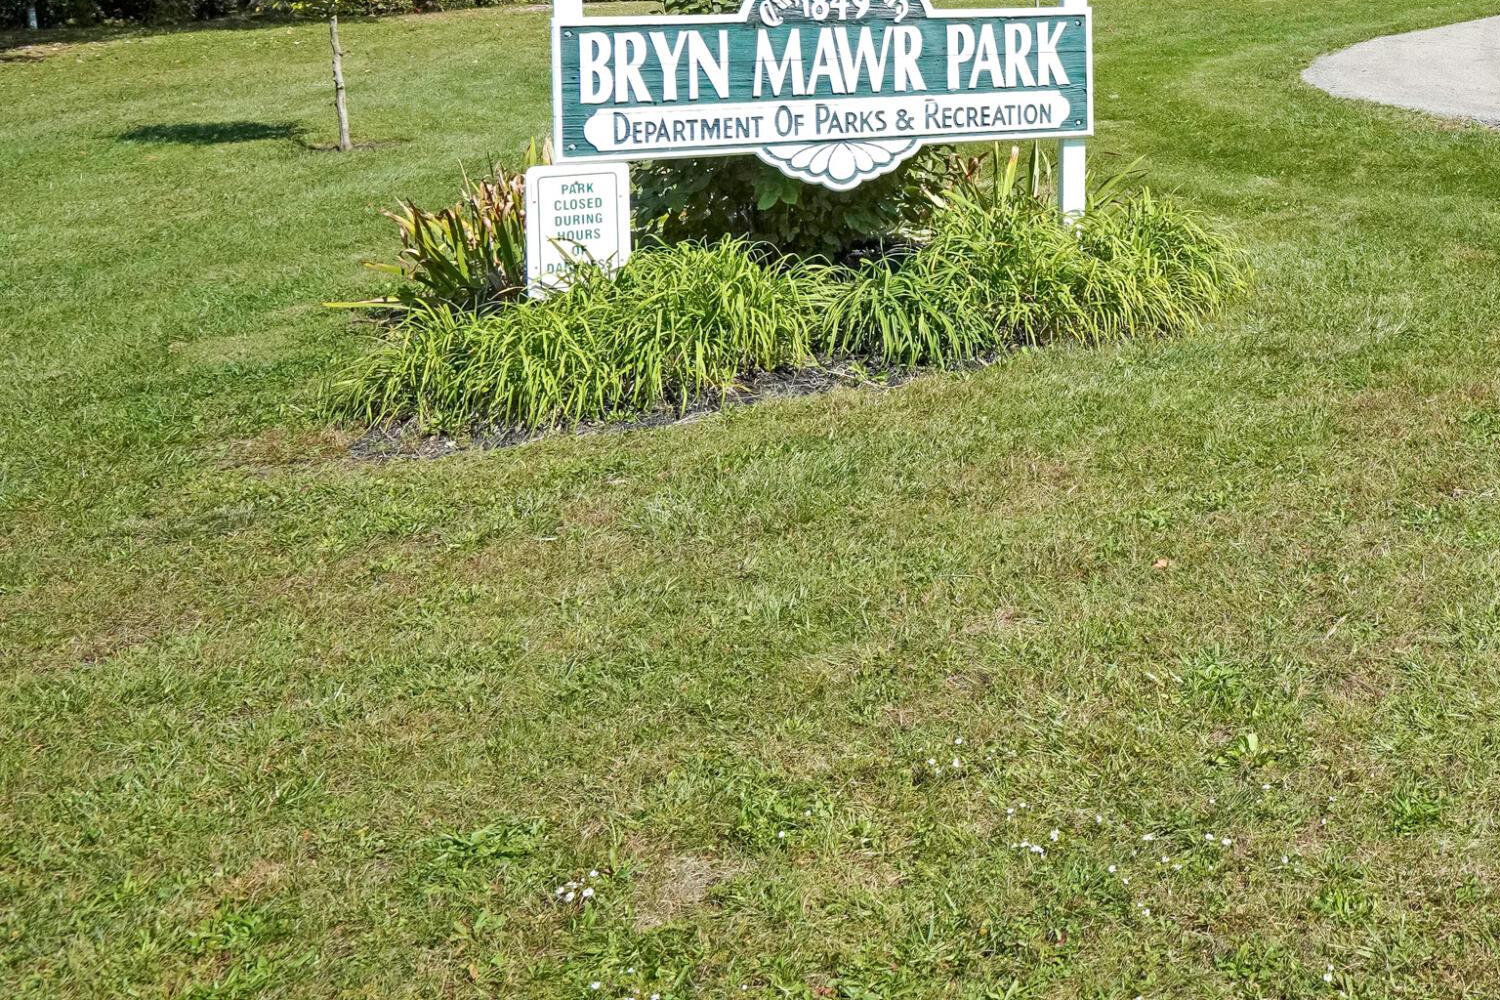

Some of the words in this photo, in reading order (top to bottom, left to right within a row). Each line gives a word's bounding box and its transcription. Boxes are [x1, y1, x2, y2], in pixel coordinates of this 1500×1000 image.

[578, 29, 730, 104] BRYN
[752, 25, 927, 98] MAWR
[946, 21, 1071, 90] PARK
[895, 108, 915, 131] &
[561, 182, 594, 195] PARK
[554, 197, 603, 212] CLOSED
[554, 213, 603, 227] DURING
[557, 228, 601, 241] HOURS
